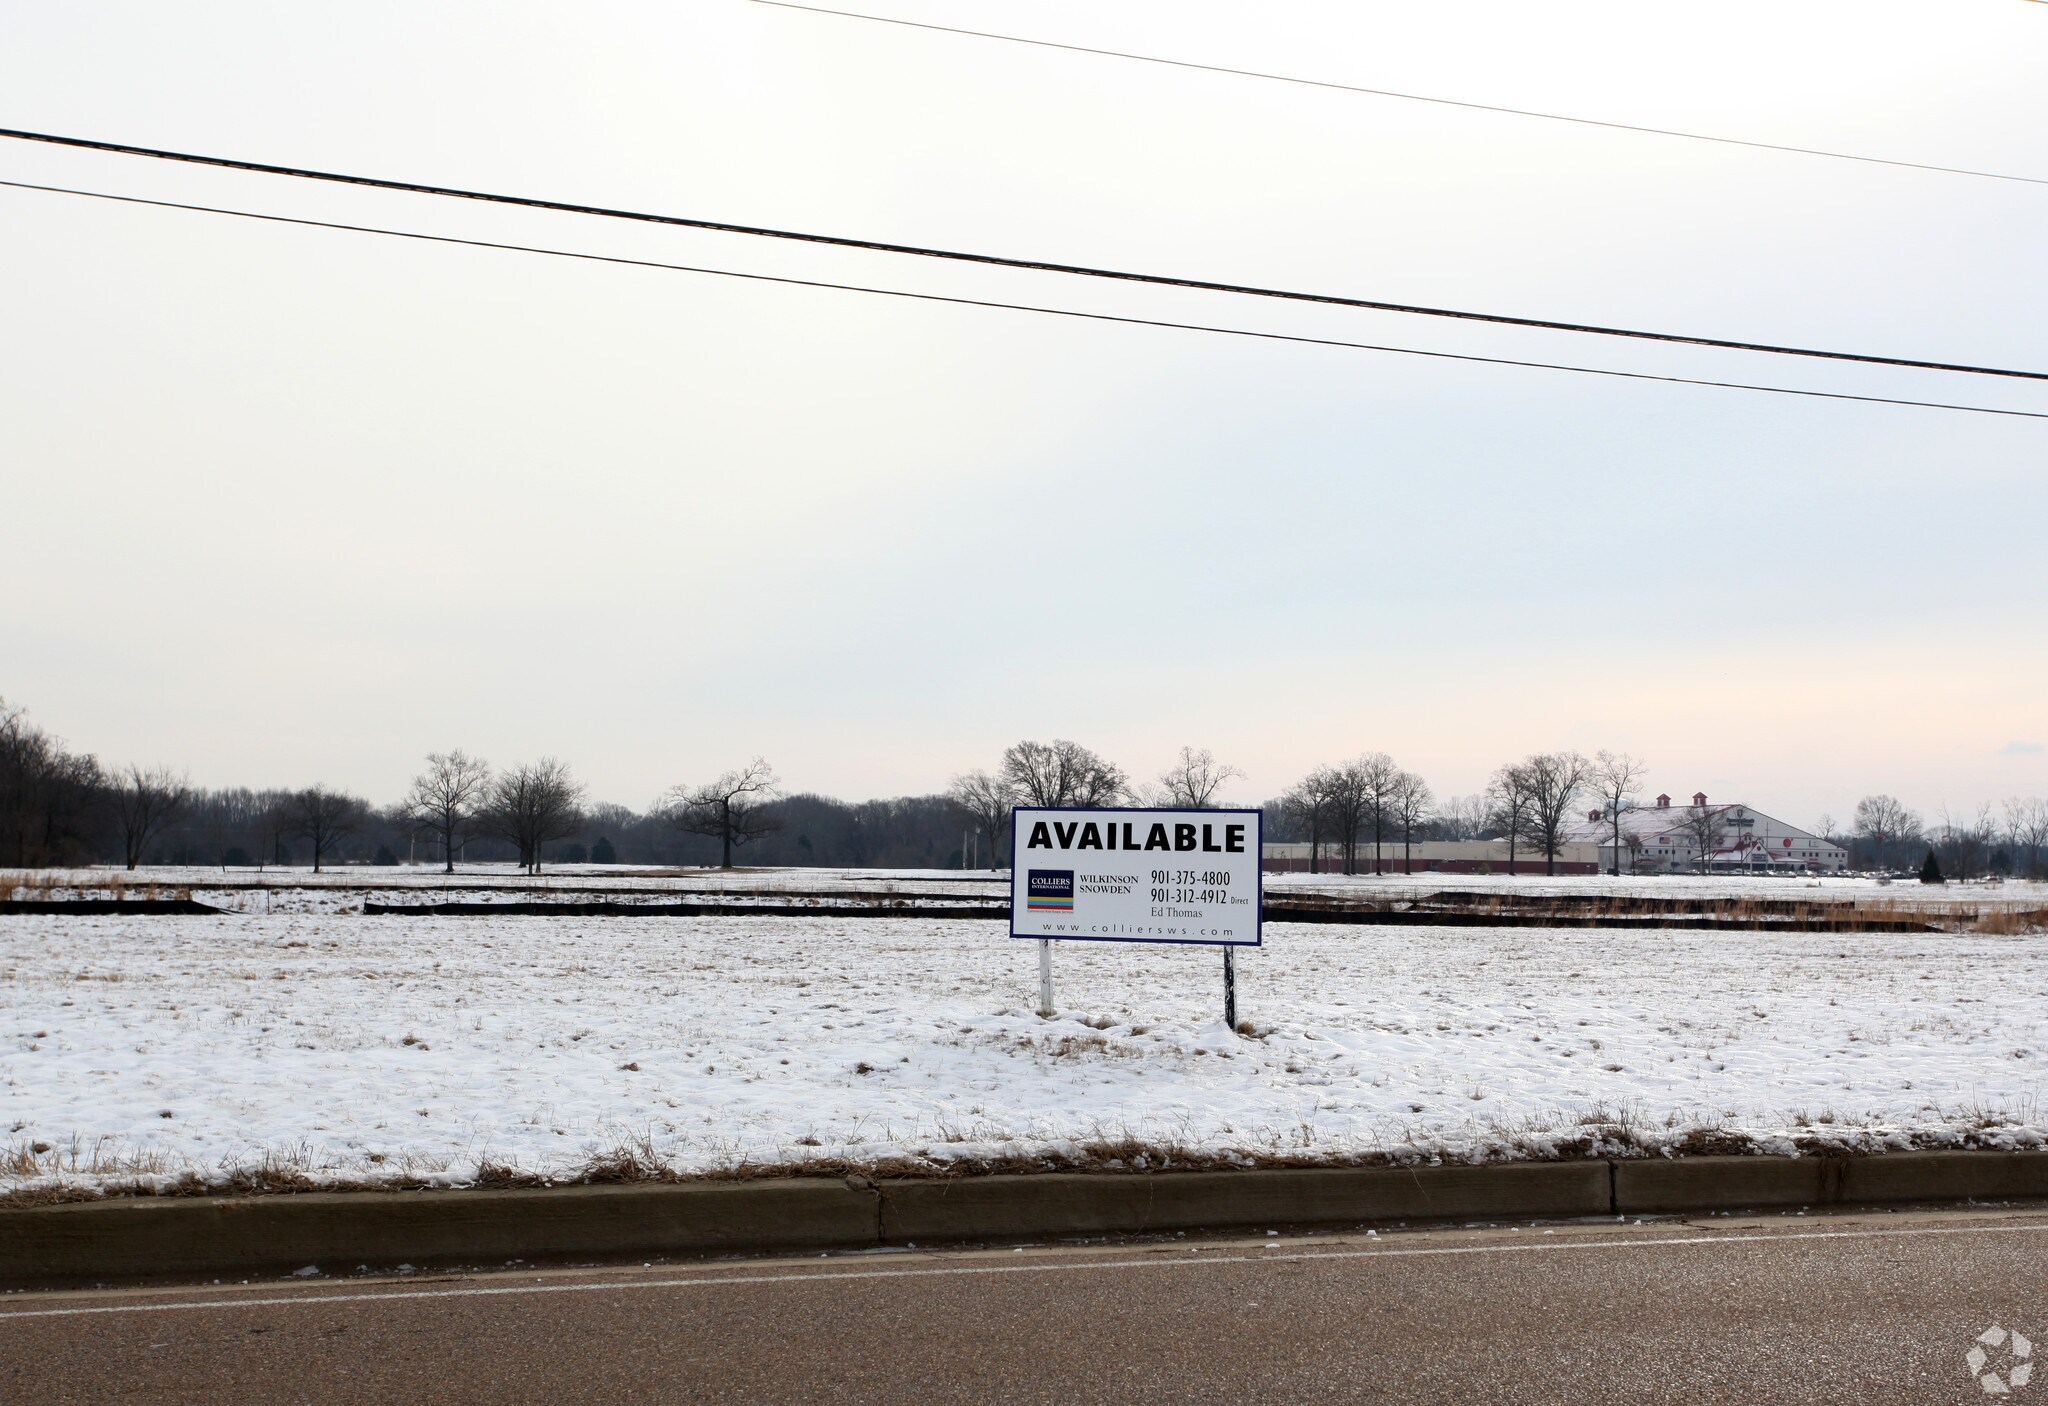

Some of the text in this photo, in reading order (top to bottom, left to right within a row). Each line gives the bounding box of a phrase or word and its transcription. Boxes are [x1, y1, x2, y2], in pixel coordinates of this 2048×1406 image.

[1027, 821, 1245, 853] AVAILABLE
[1079, 874, 1139, 884] WILKINSON
[1151, 870, 1230, 886] 901-375-4800
[1079, 885, 1131, 894] SNOWDEN
[1151, 888, 1249, 905] 901-312-4912 Direct
[1151, 907, 1203, 918] Ed Thomas
